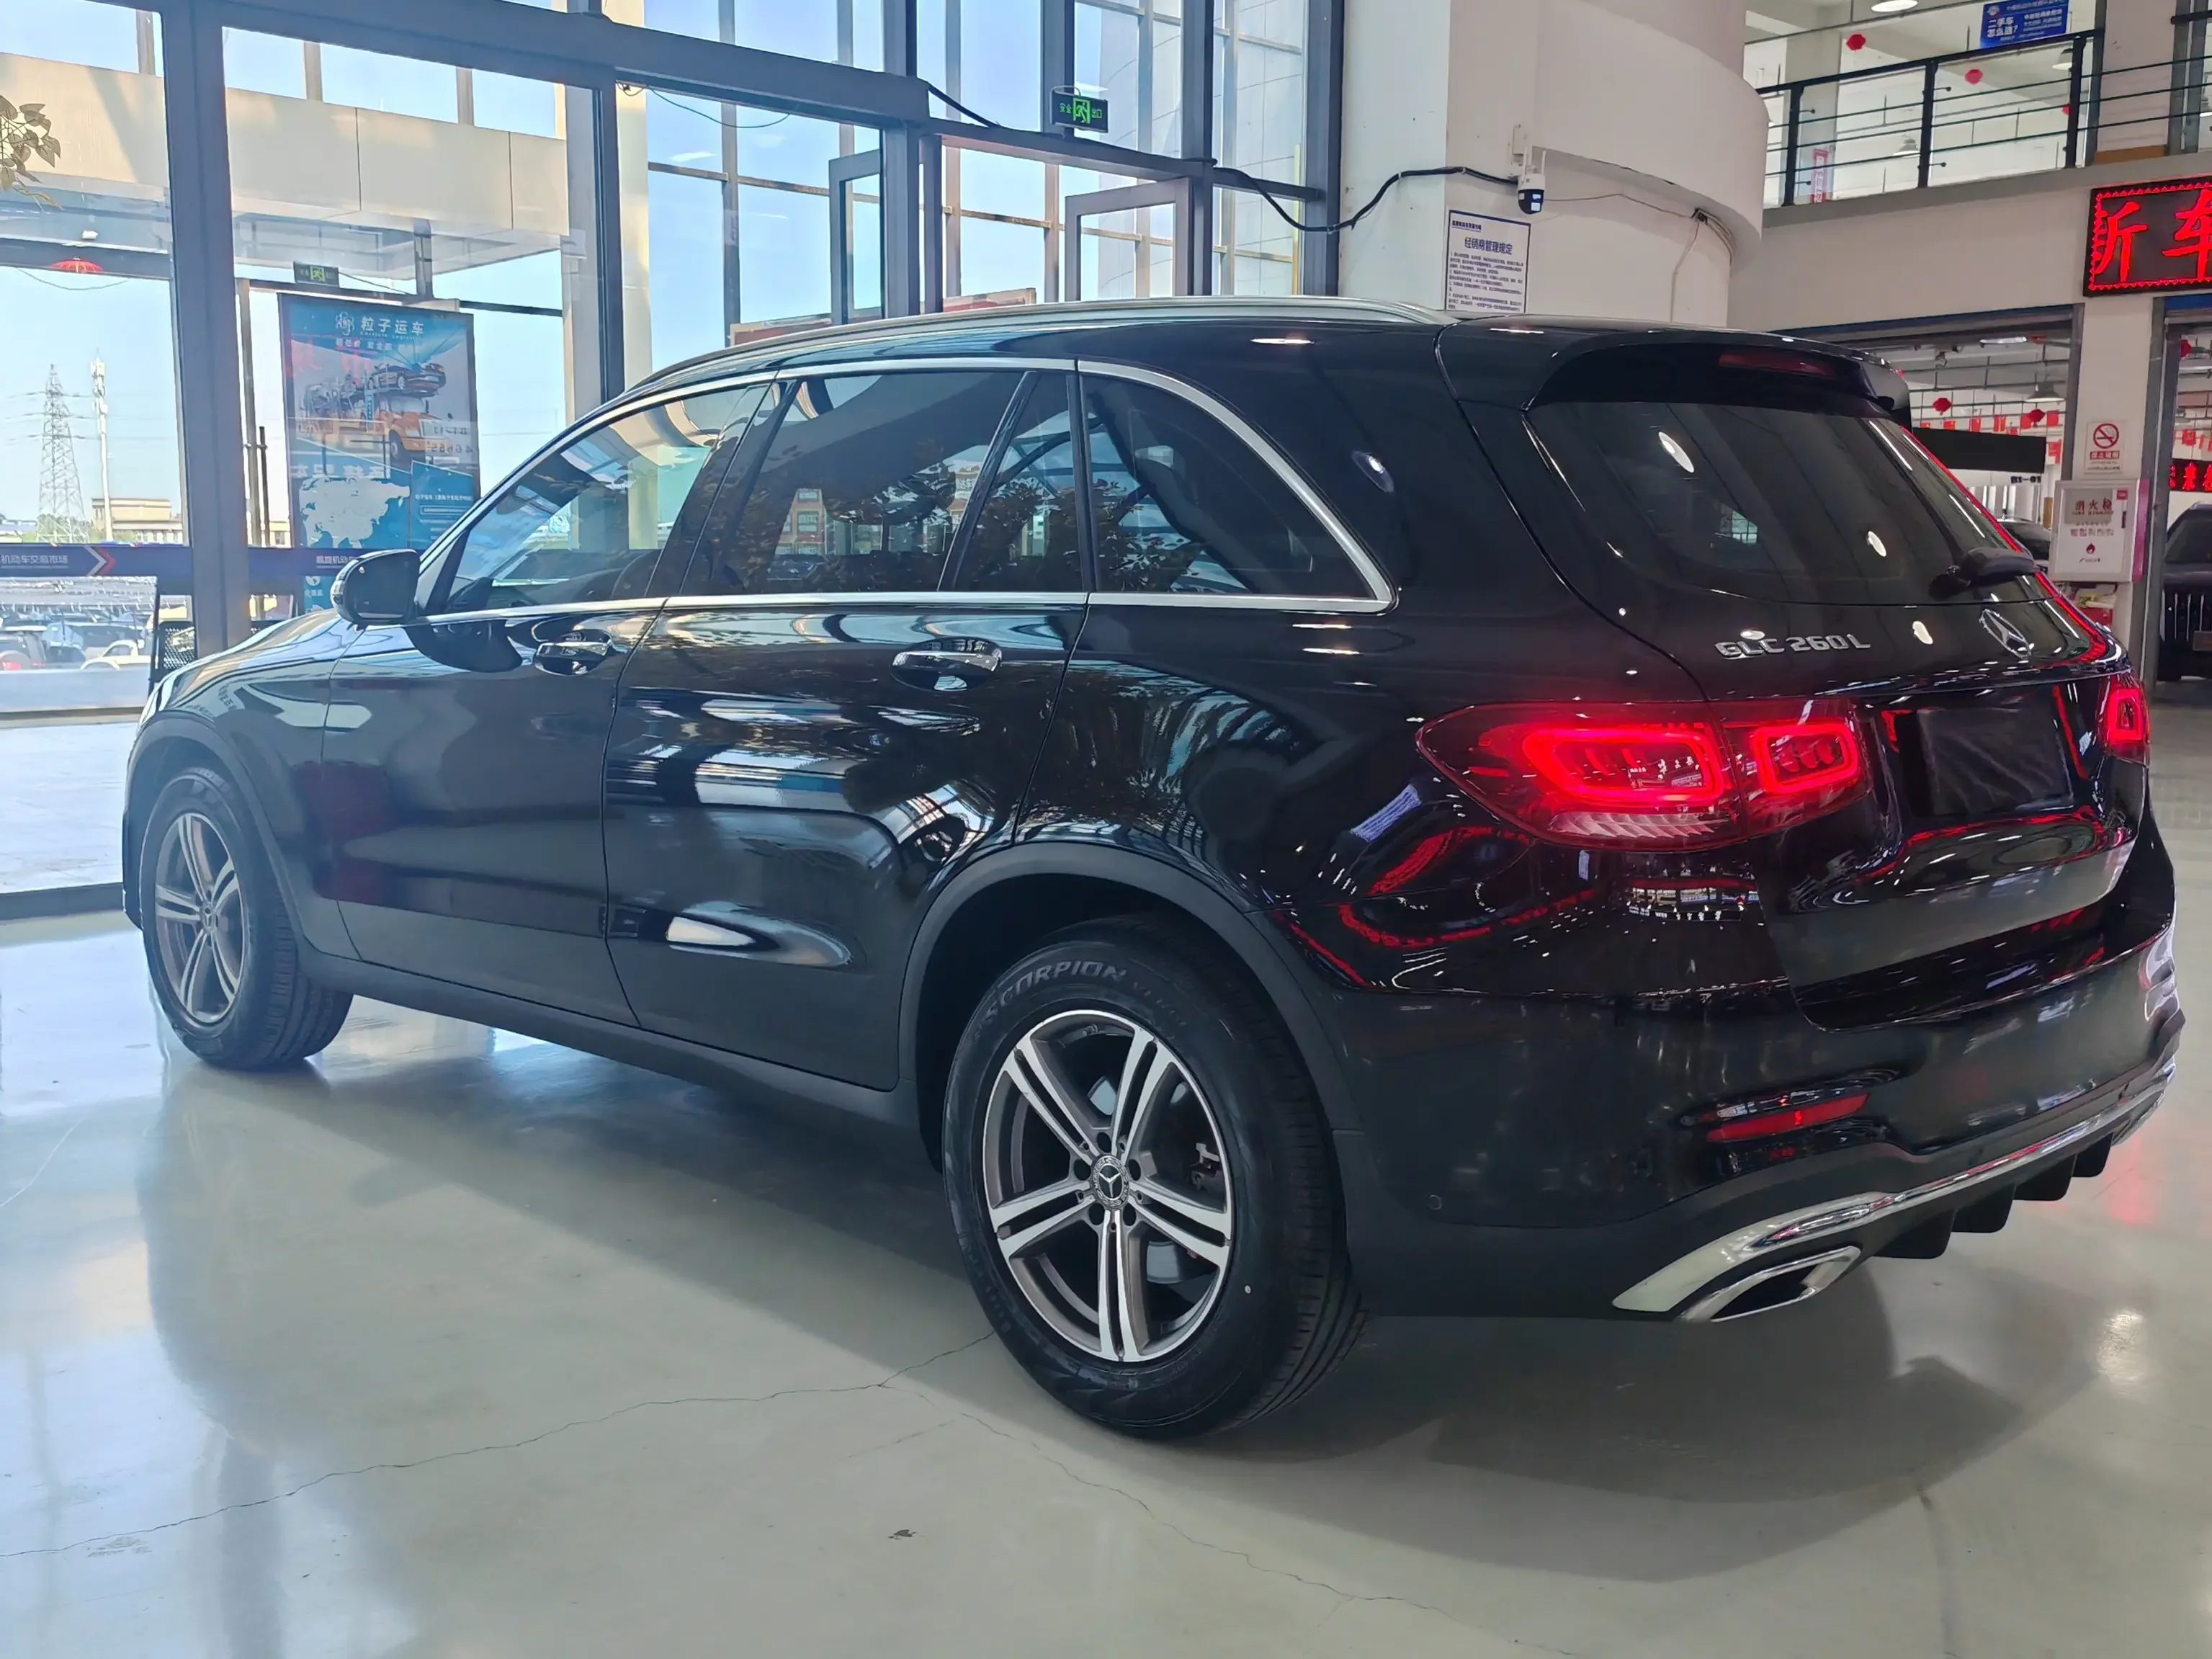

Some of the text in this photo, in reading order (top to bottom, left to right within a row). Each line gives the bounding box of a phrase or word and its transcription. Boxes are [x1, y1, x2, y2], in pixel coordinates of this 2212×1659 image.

[1464, 236, 1513, 255] 经销商管理规定
[361, 316, 424, 336] 粒子运车
[1714, 638, 1785, 657] GLC
